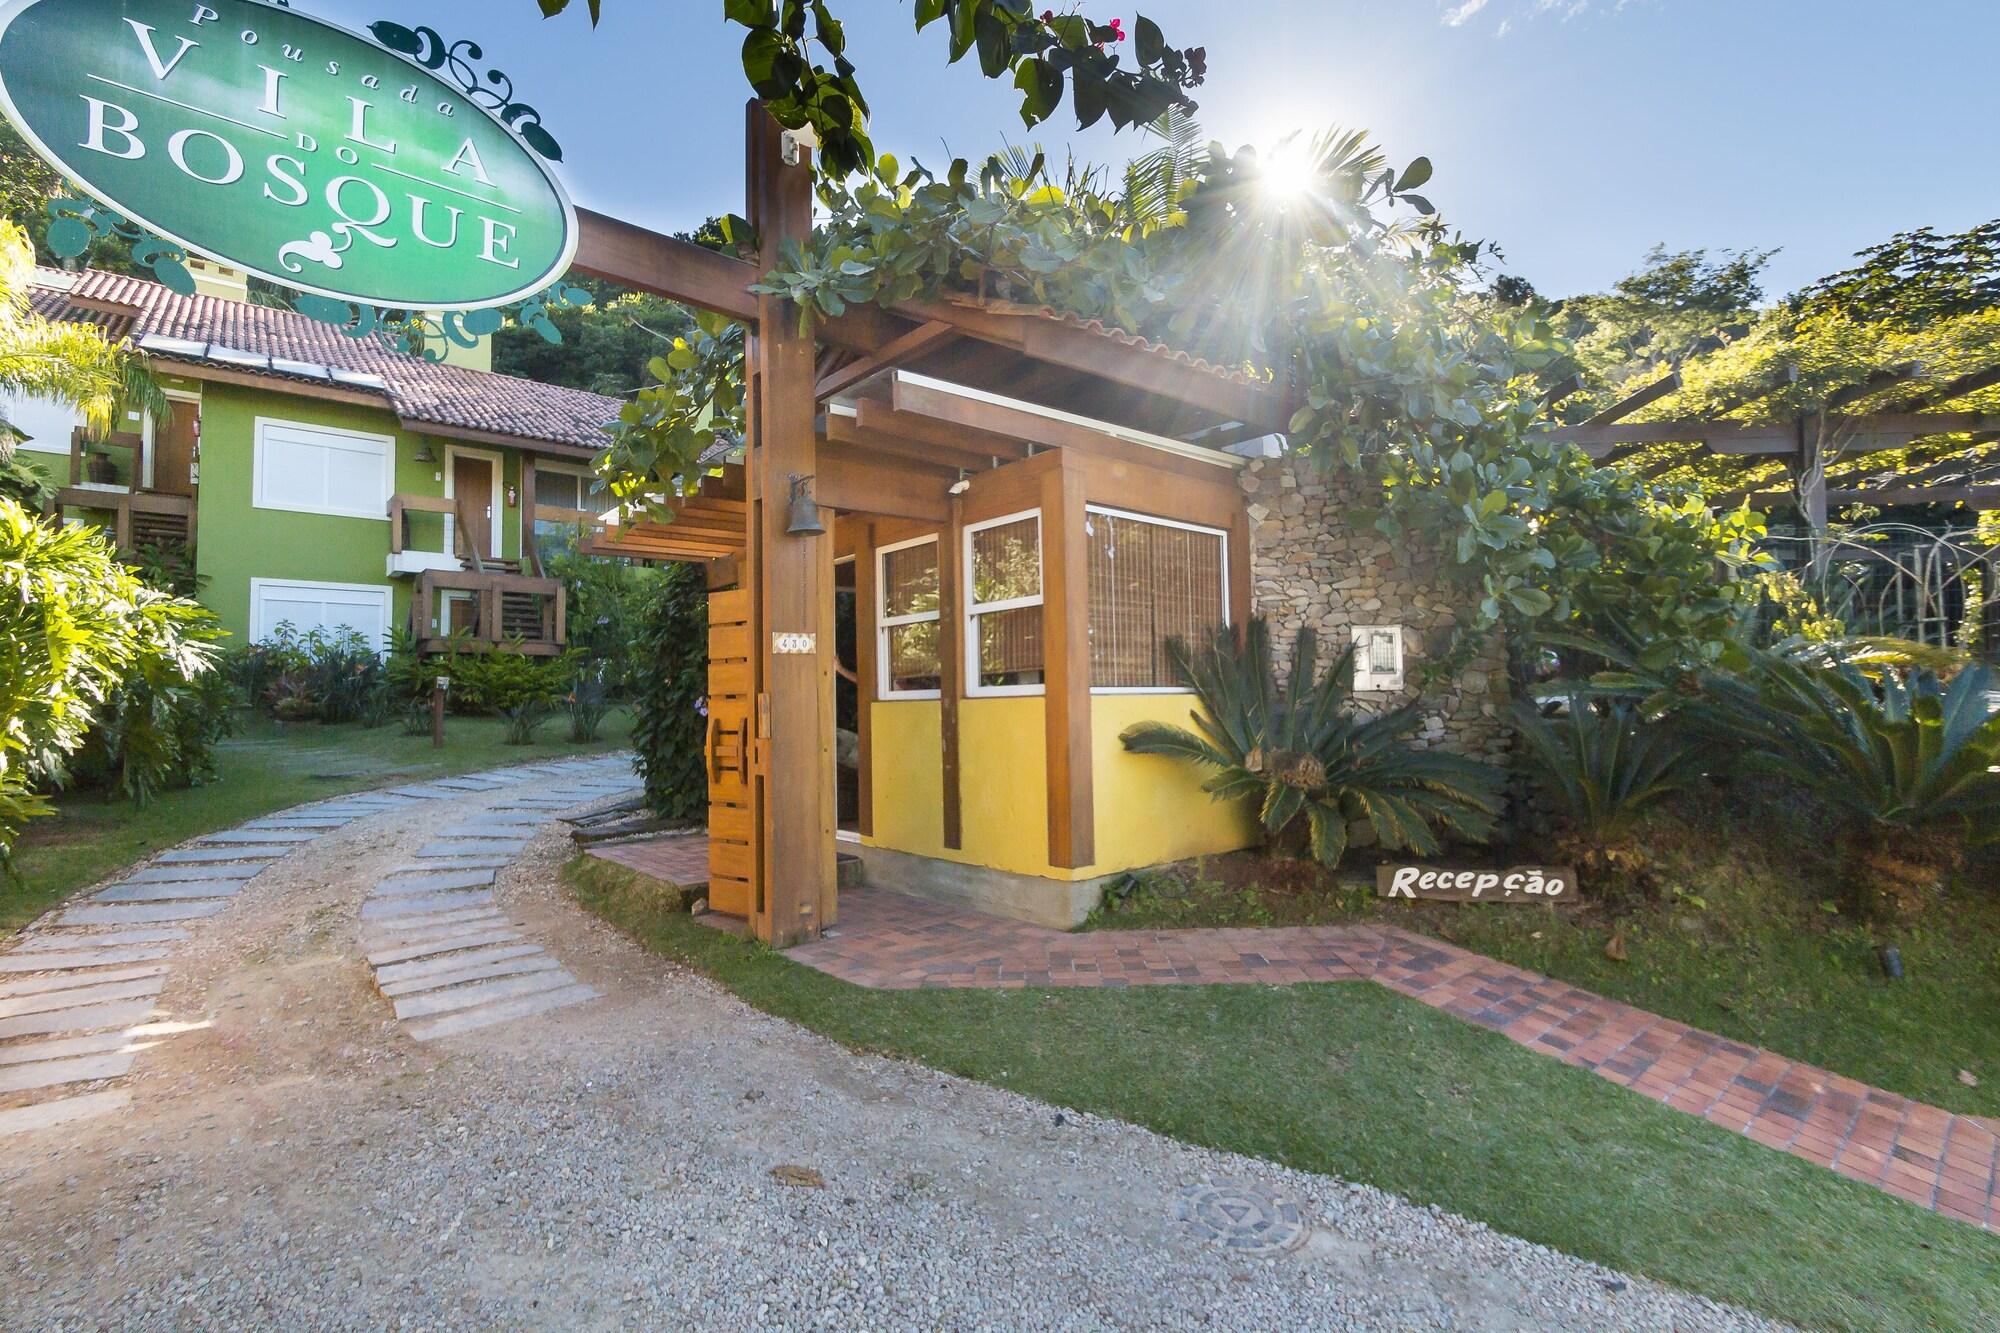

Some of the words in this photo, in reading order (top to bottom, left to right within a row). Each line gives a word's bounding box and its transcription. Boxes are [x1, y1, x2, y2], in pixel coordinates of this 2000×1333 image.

[122, 16, 498, 188] VILA
[189, 3, 457, 119] Pousada
[78, 93, 521, 270] BOSQUE
[296, 131, 360, 165] DO
